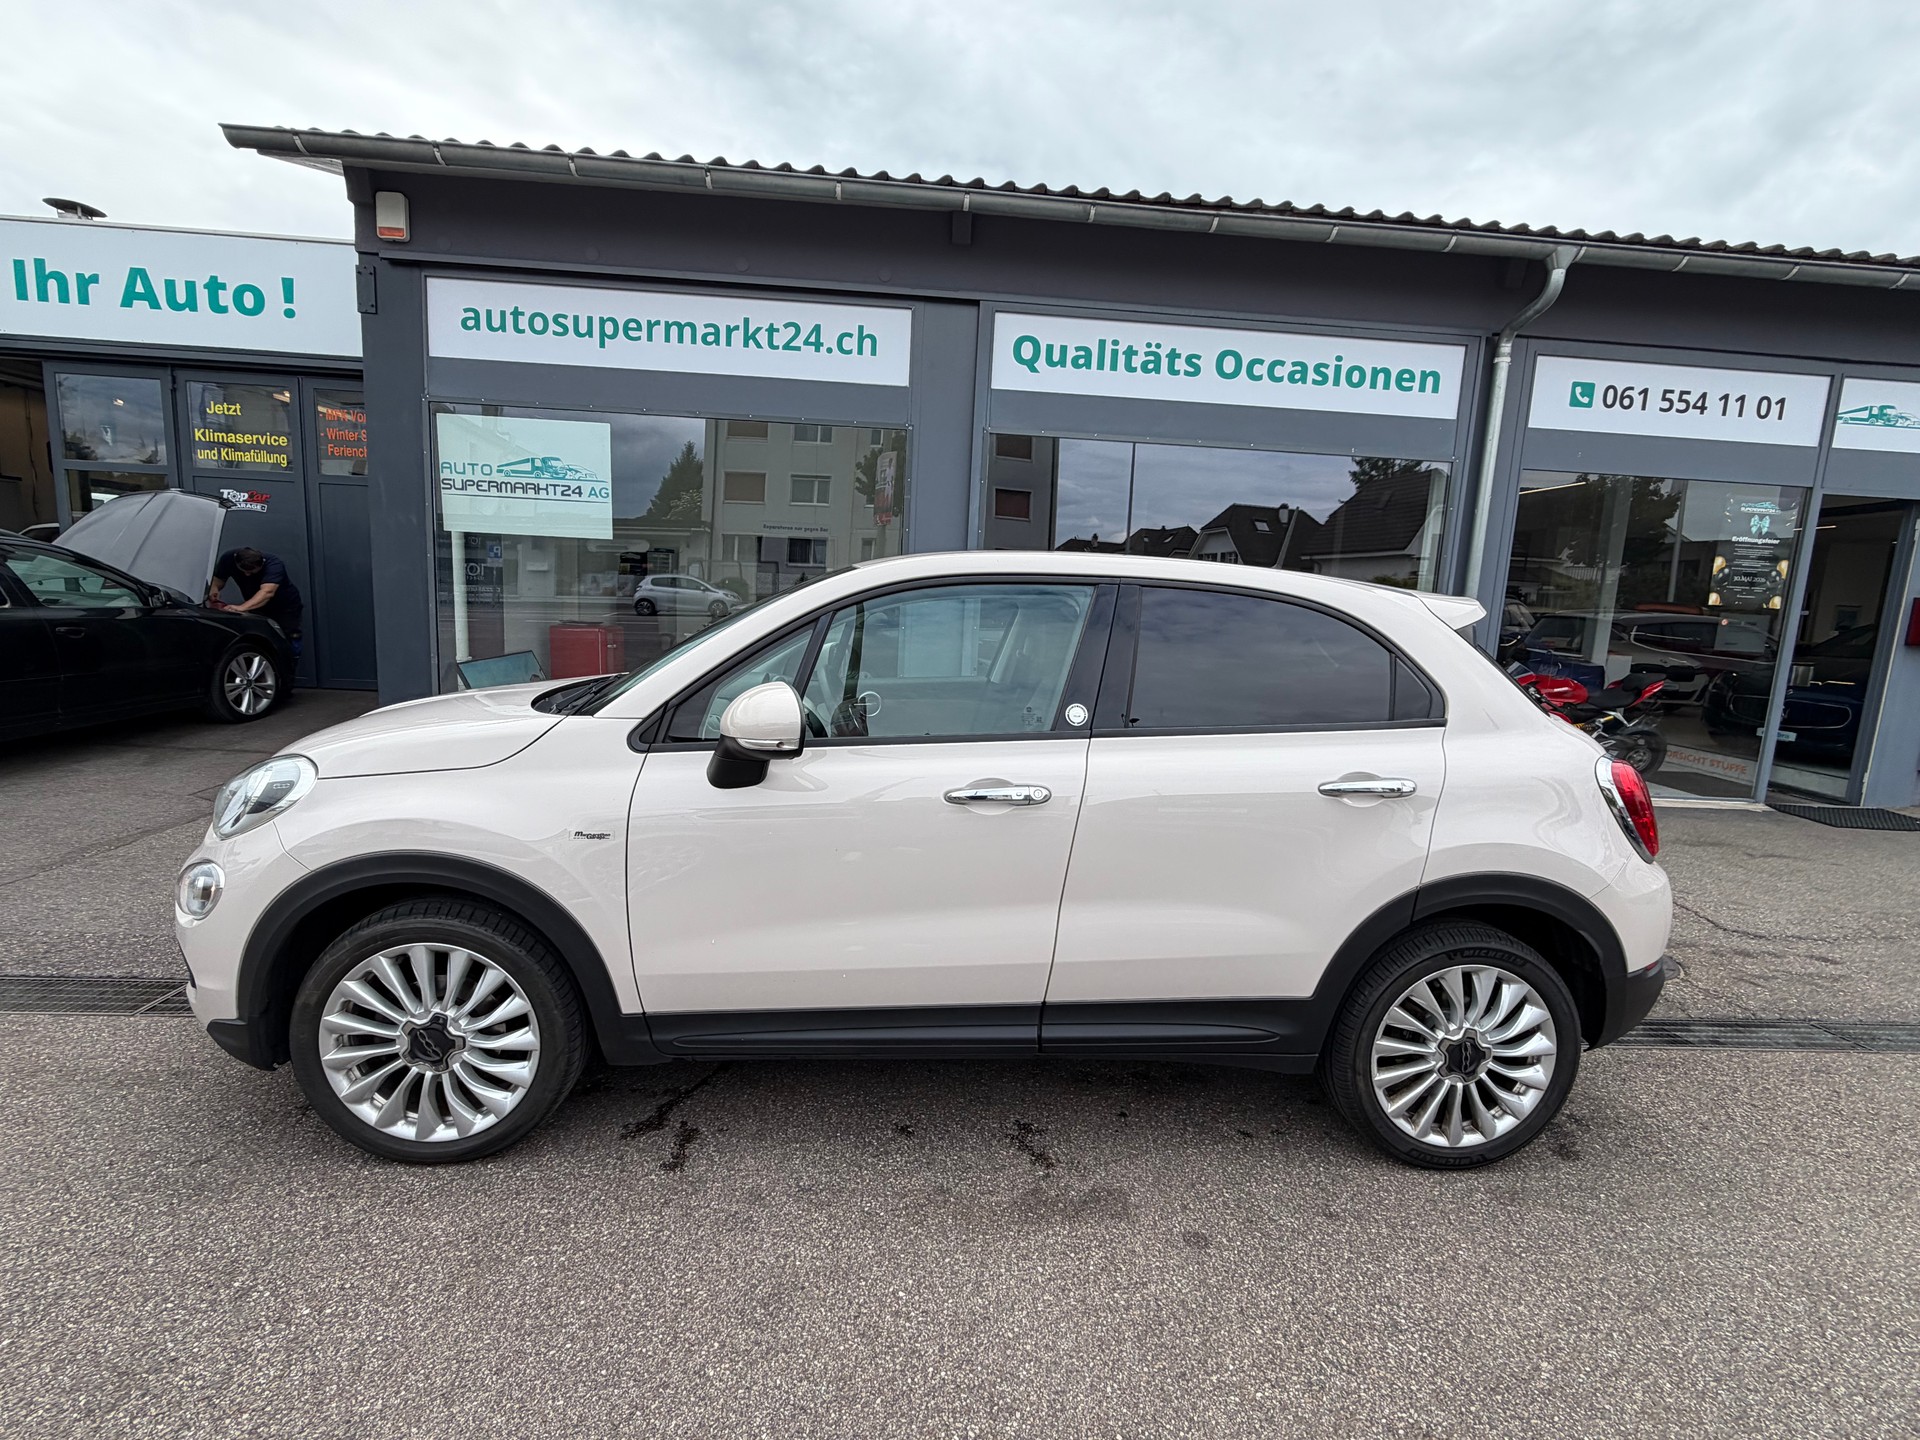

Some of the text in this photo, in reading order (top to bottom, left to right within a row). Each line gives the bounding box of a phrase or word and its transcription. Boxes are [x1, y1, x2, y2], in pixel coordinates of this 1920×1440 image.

[12, 257, 100, 306] Ihr
[119, 266, 266, 319] Auto
[460, 305, 879, 357] autosupermarkt24.ch
[1012, 335, 1442, 395] Qualitäts Occasionen
[206, 401, 242, 416] Jetzt
[1602, 384, 1787, 421] 061 554 11 01
[194, 428, 288, 447] Klimaservice
[326, 427, 359, 441] Winter
[197, 447, 288, 468] und Klimafüllung
[440, 461, 493, 477] AUTO
[441, 477, 610, 499] SUPERMARKT24 AG
[234, 502, 262, 510] ARAGE
[1731, 535, 1781, 545] Eröffnungsfeier
[1667, 750, 1708, 766] ORSICHT
